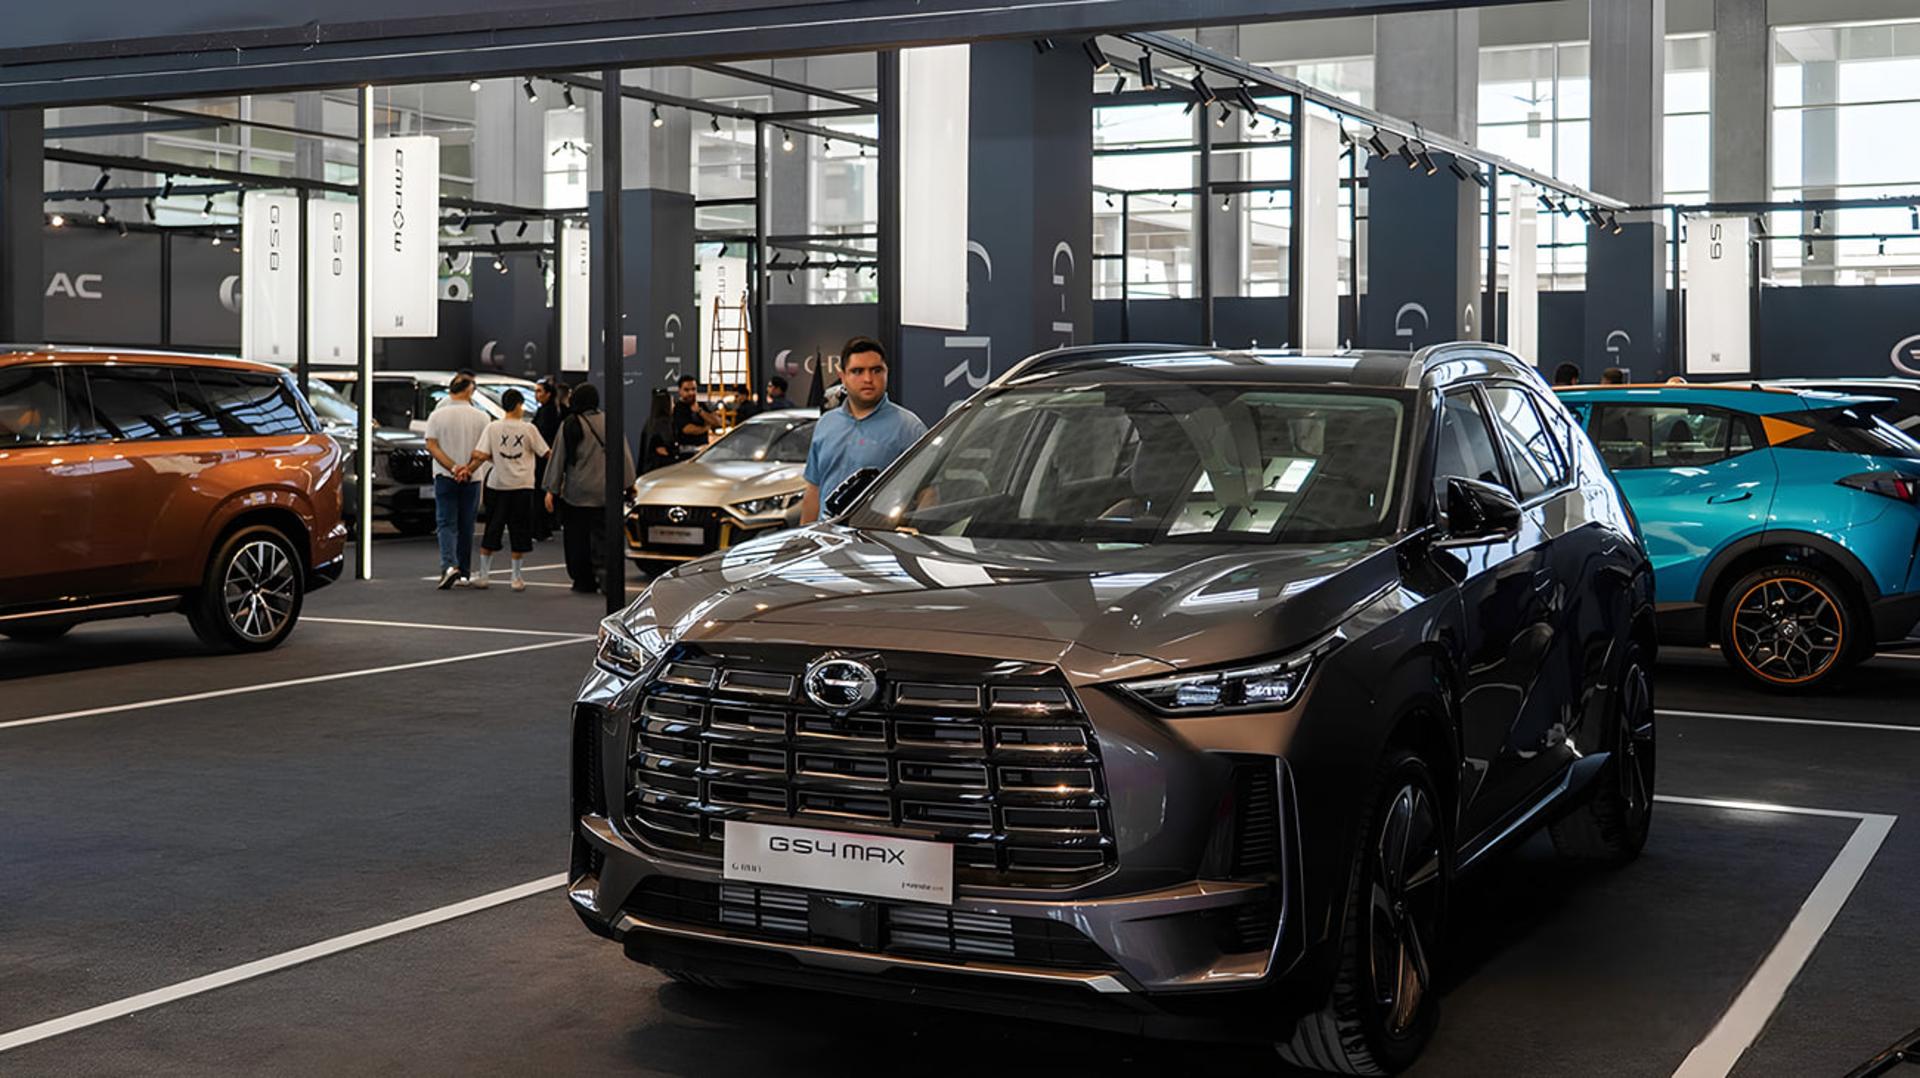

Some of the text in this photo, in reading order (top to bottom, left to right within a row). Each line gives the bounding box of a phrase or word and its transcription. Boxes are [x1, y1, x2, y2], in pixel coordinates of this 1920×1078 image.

[1709, 223, 1722, 260] S9
[769, 836, 905, 866] GS4 MAX
